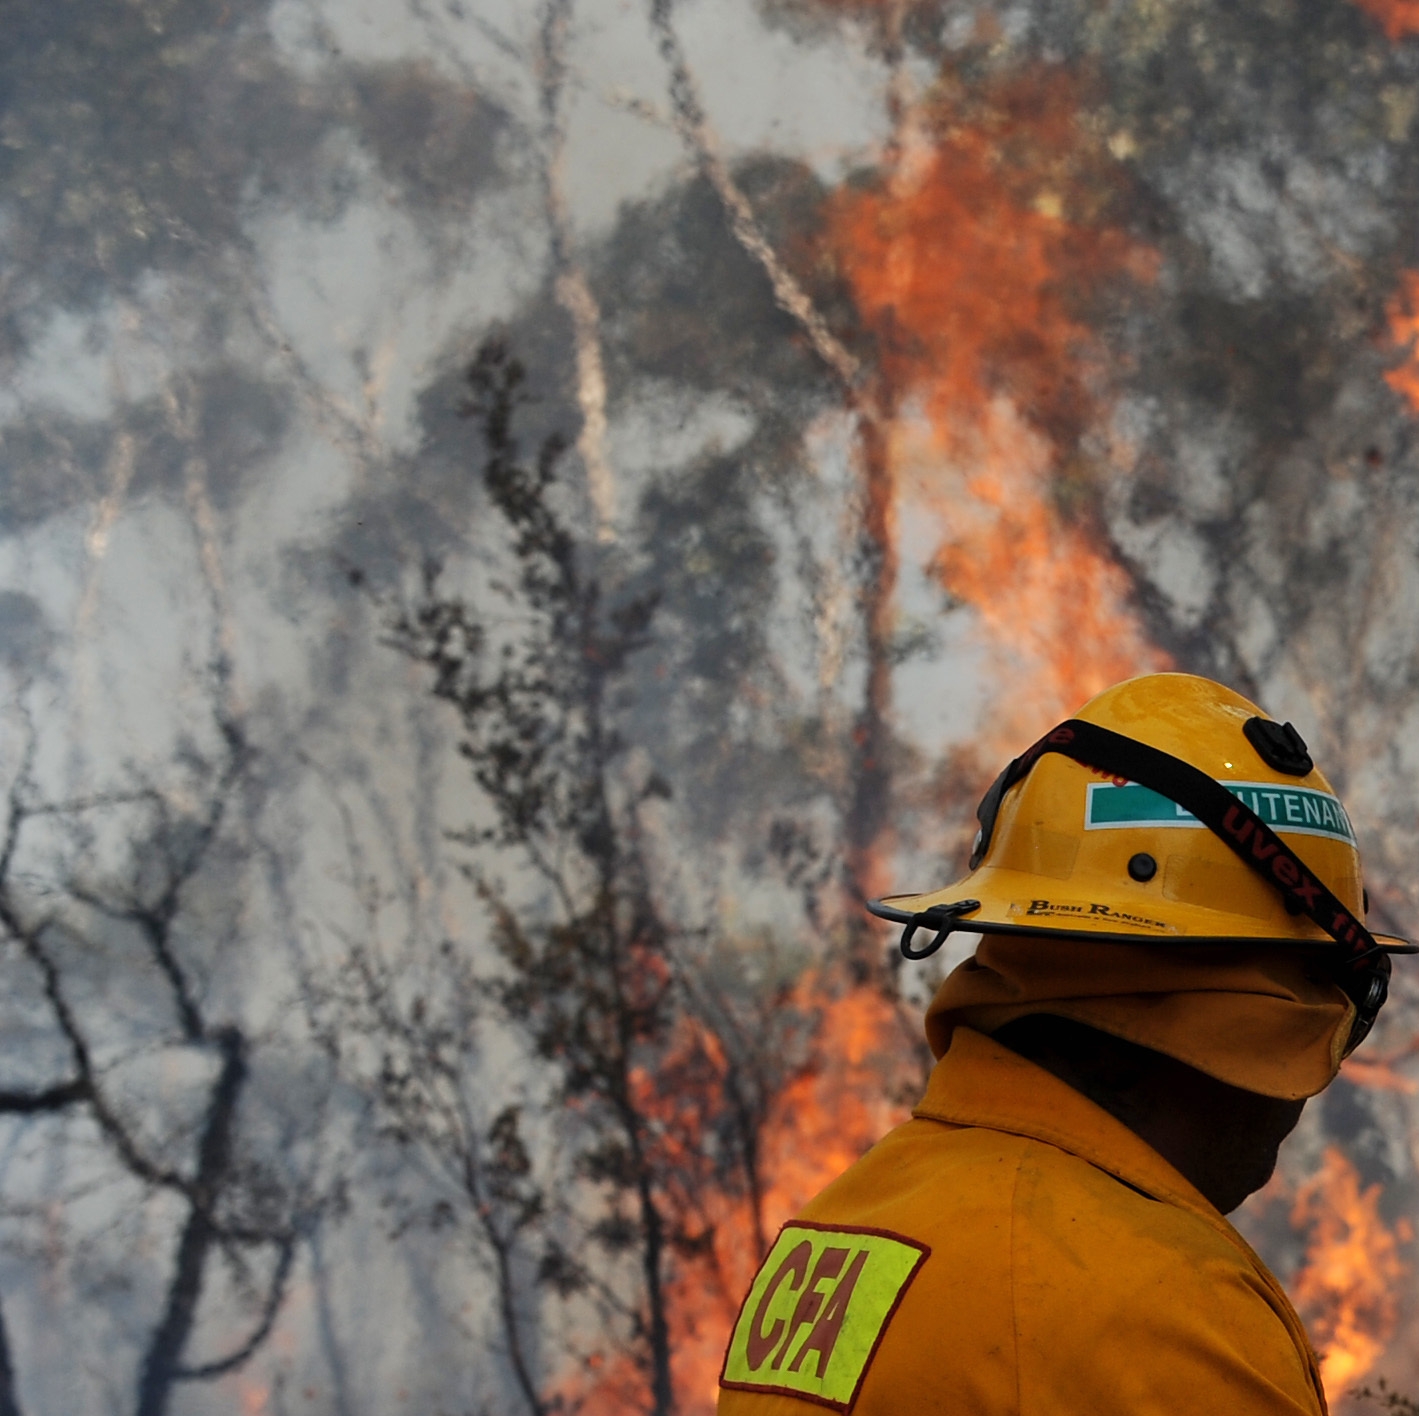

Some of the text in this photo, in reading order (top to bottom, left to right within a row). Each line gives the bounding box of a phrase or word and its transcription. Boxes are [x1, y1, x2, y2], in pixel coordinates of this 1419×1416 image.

[1222, 803, 1324, 910] uvex
[1088, 903, 1166, 928] RANGER
[746, 1239, 870, 1379] CFA
